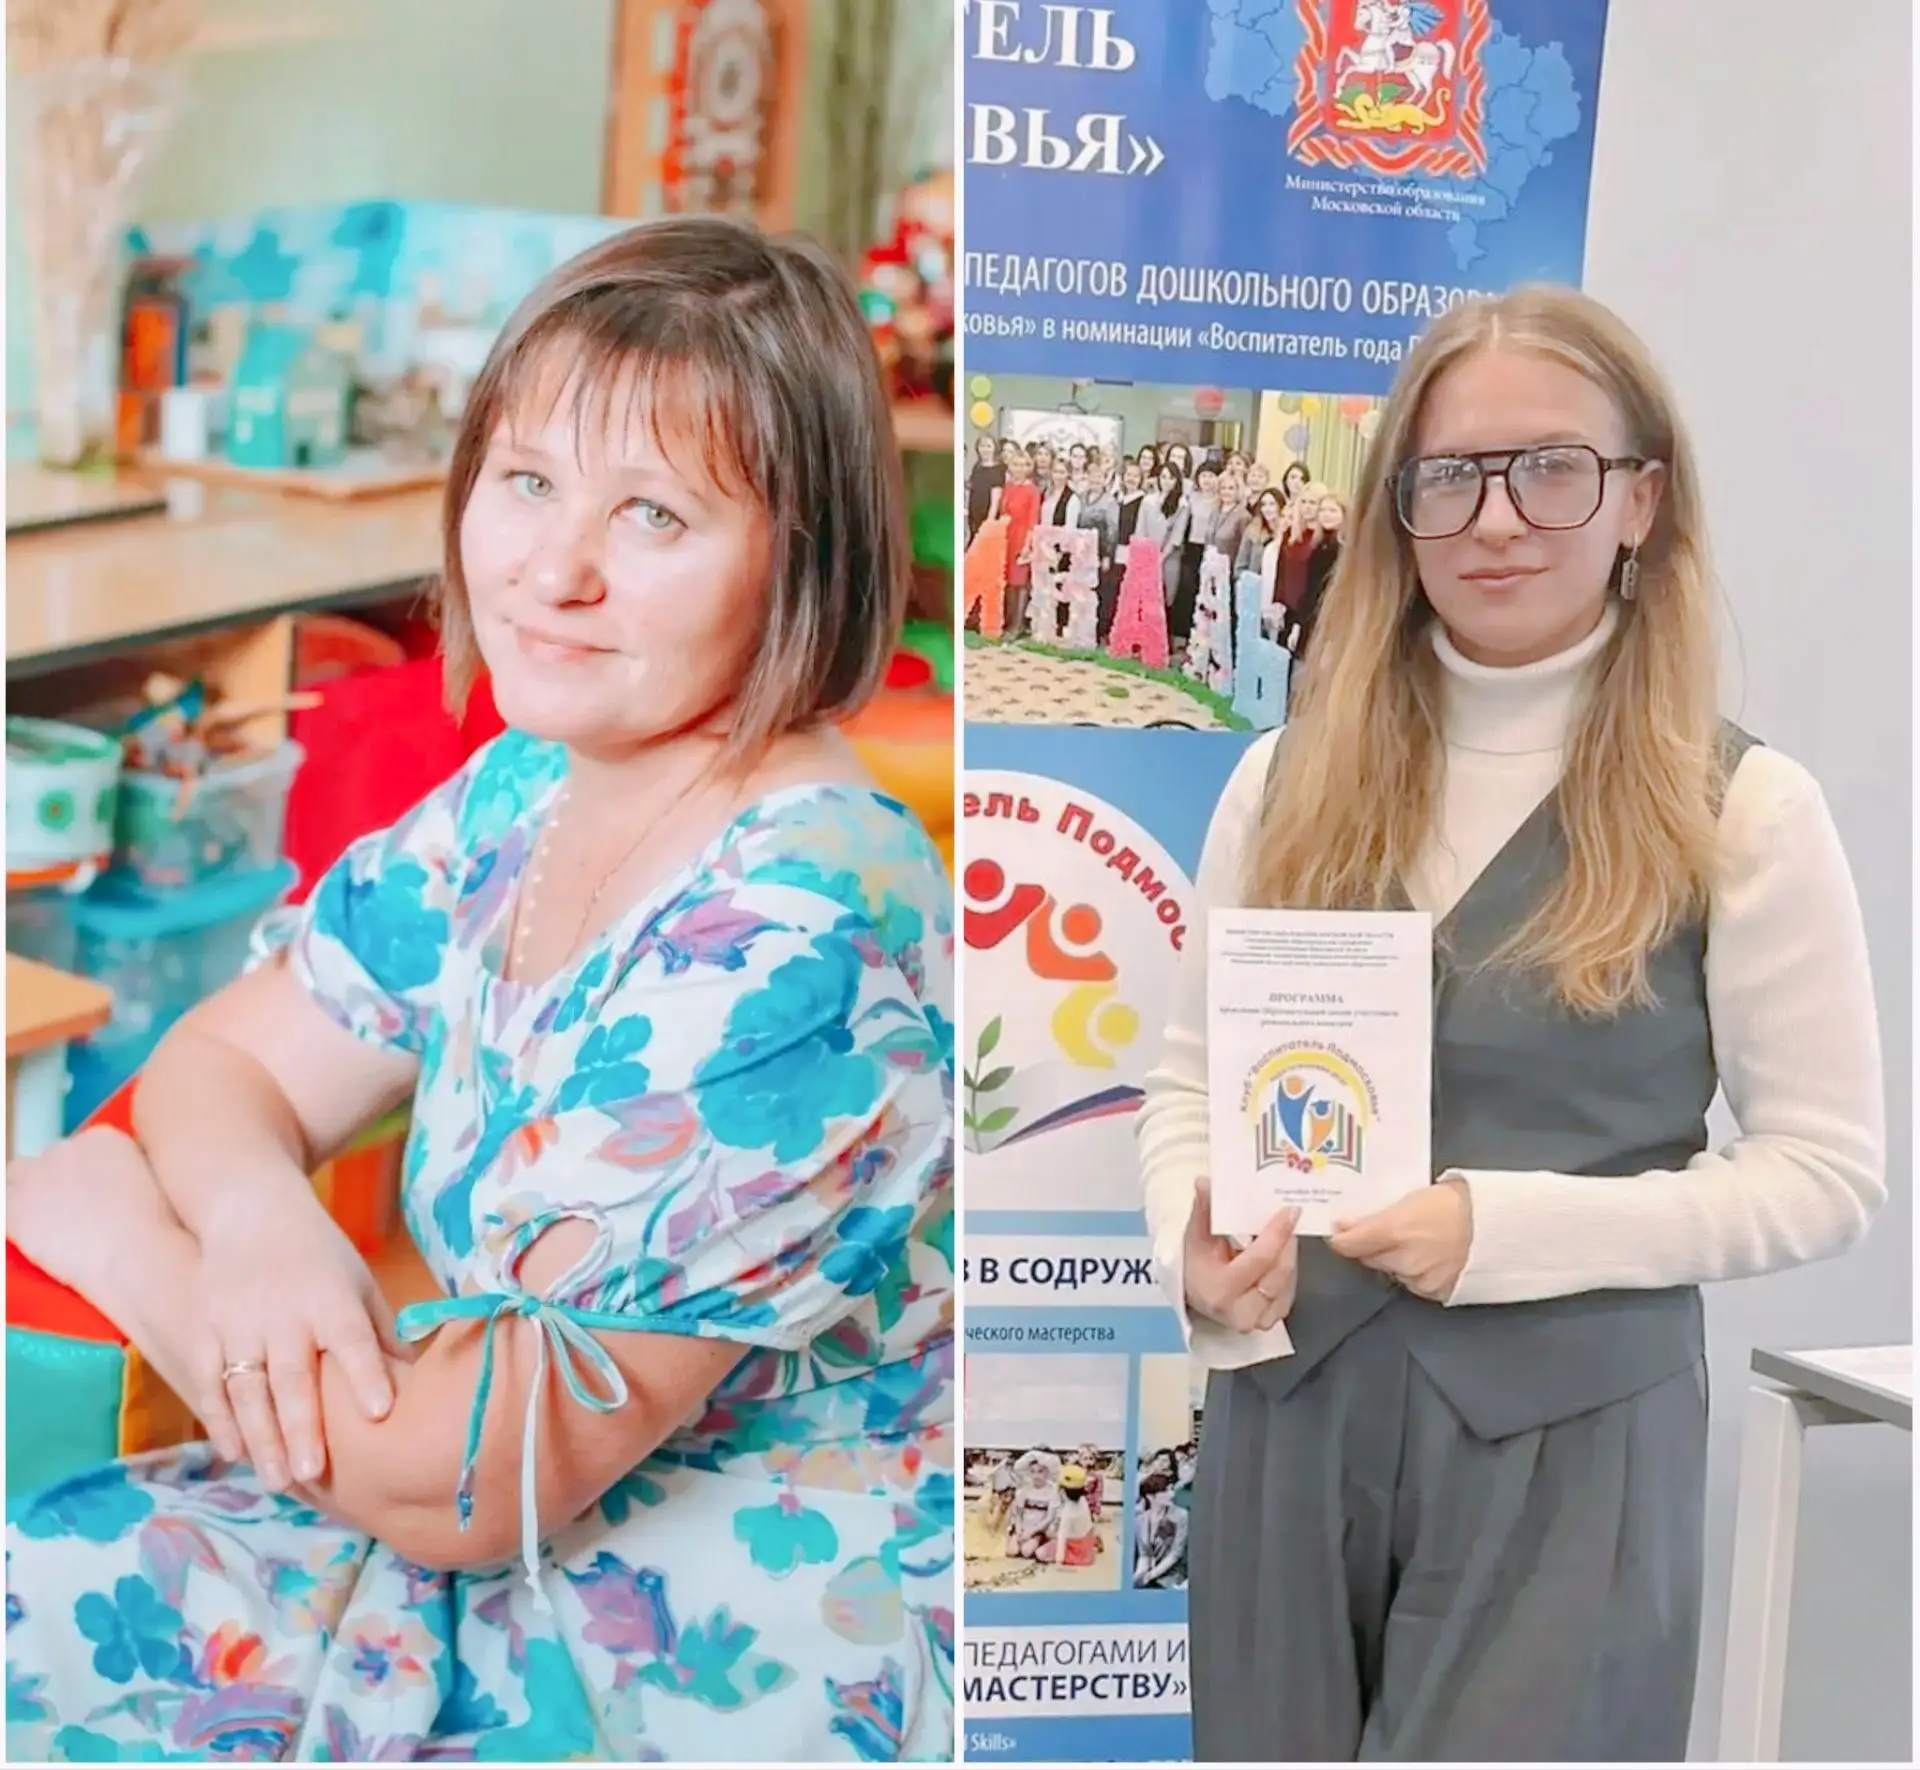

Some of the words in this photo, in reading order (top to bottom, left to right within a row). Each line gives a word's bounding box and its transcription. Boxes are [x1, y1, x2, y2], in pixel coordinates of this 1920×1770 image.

[964, 0, 1136, 71] ЕЛЬ
[966, 102, 1166, 177] ВЬЯ»
[1284, 173, 1395, 198] Министерство
[1397, 183, 1487, 206] образования
[1311, 195, 1402, 217] Московской
[1404, 204, 1460, 222] области
[964, 252, 1128, 298] ПЕДАГОГОВ
[1136, 263, 1353, 313] ДОШКОЛЬНОГО
[1043, 317, 1056, 339] в
[1062, 319, 1192, 350] номинации
[1197, 322, 1348, 359] «Воспитатель
[1353, 338, 1402, 365] года
[1267, 992, 1345, 1005] ПРОГРАММА
[980, 1257, 999, 1284] В
[1009, 1257, 1160, 1290] СОДРУЖ
[1028, 1325, 1115, 1344] мастерства
[964, 1639, 1157, 1671] ПЕДАГОГАМИ
[1167, 1638, 1186, 1663] И
[971, 1733, 1018, 1751] Skills»
